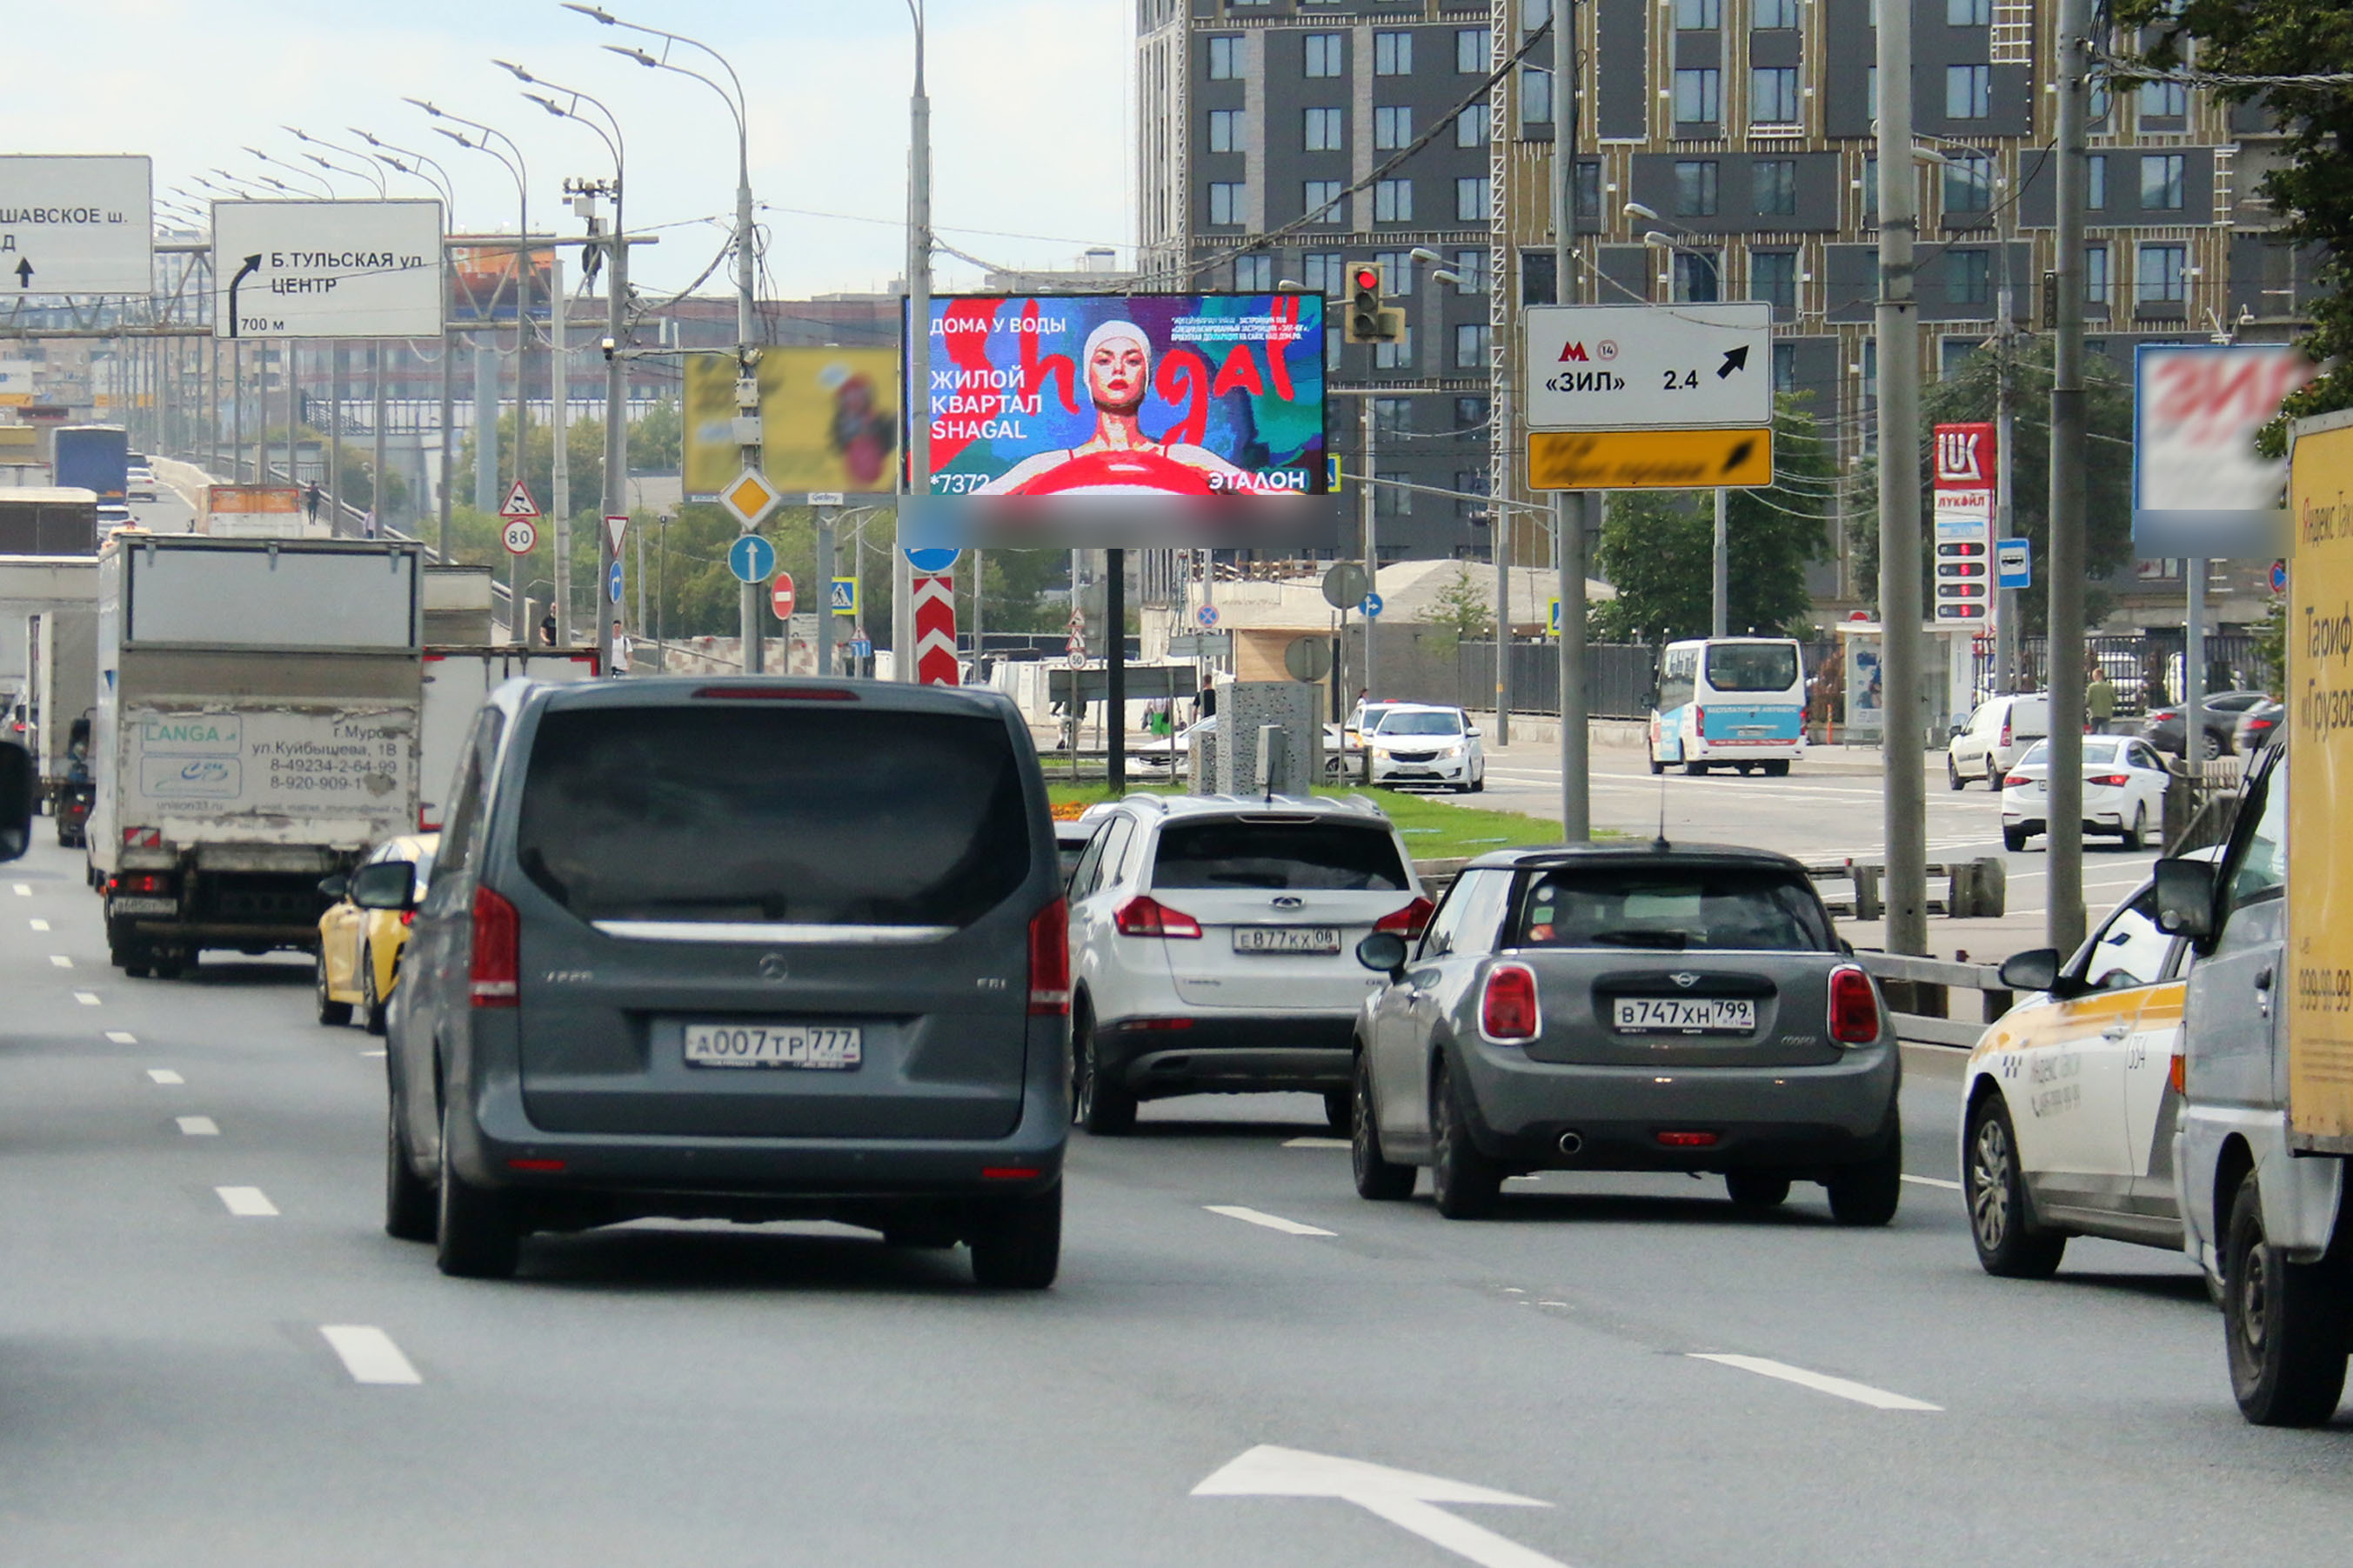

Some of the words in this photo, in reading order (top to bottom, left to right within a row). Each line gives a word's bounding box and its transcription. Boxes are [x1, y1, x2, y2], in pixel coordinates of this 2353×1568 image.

[107, 211, 128, 224] ш.
[0, 234, 16, 252] Д
[271, 251, 393, 268] Б.ТУЛЬСКАЯ
[399, 256, 426, 270] ул.
[271, 277, 338, 296] ЦЕНТР
[240, 318, 268, 331] 700
[272, 321, 284, 331] м
[930, 317, 988, 336] ДОМА
[992, 317, 1006, 333] У
[1009, 317, 1066, 335] ВОДЫ
[931, 364, 1026, 390] ЖИЛОЙ
[1545, 371, 1626, 392] «ЗИЛ»
[1663, 370, 1699, 390] 2.4
[931, 394, 1043, 414] КВАРТАЛ
[931, 419, 1028, 439] SHAGAL
[1208, 470, 1305, 490] ЭТАЛОН
[508, 530, 530, 544] 80
[2305, 600, 2352, 669] Тариф
[1072, 655, 1082, 664] 50
[1621, 1001, 1710, 1024] В747ХН
[1714, 1001, 1748, 1019] 799
[697, 1029, 805, 1057] А007ТР
[811, 1030, 852, 1051] 777
